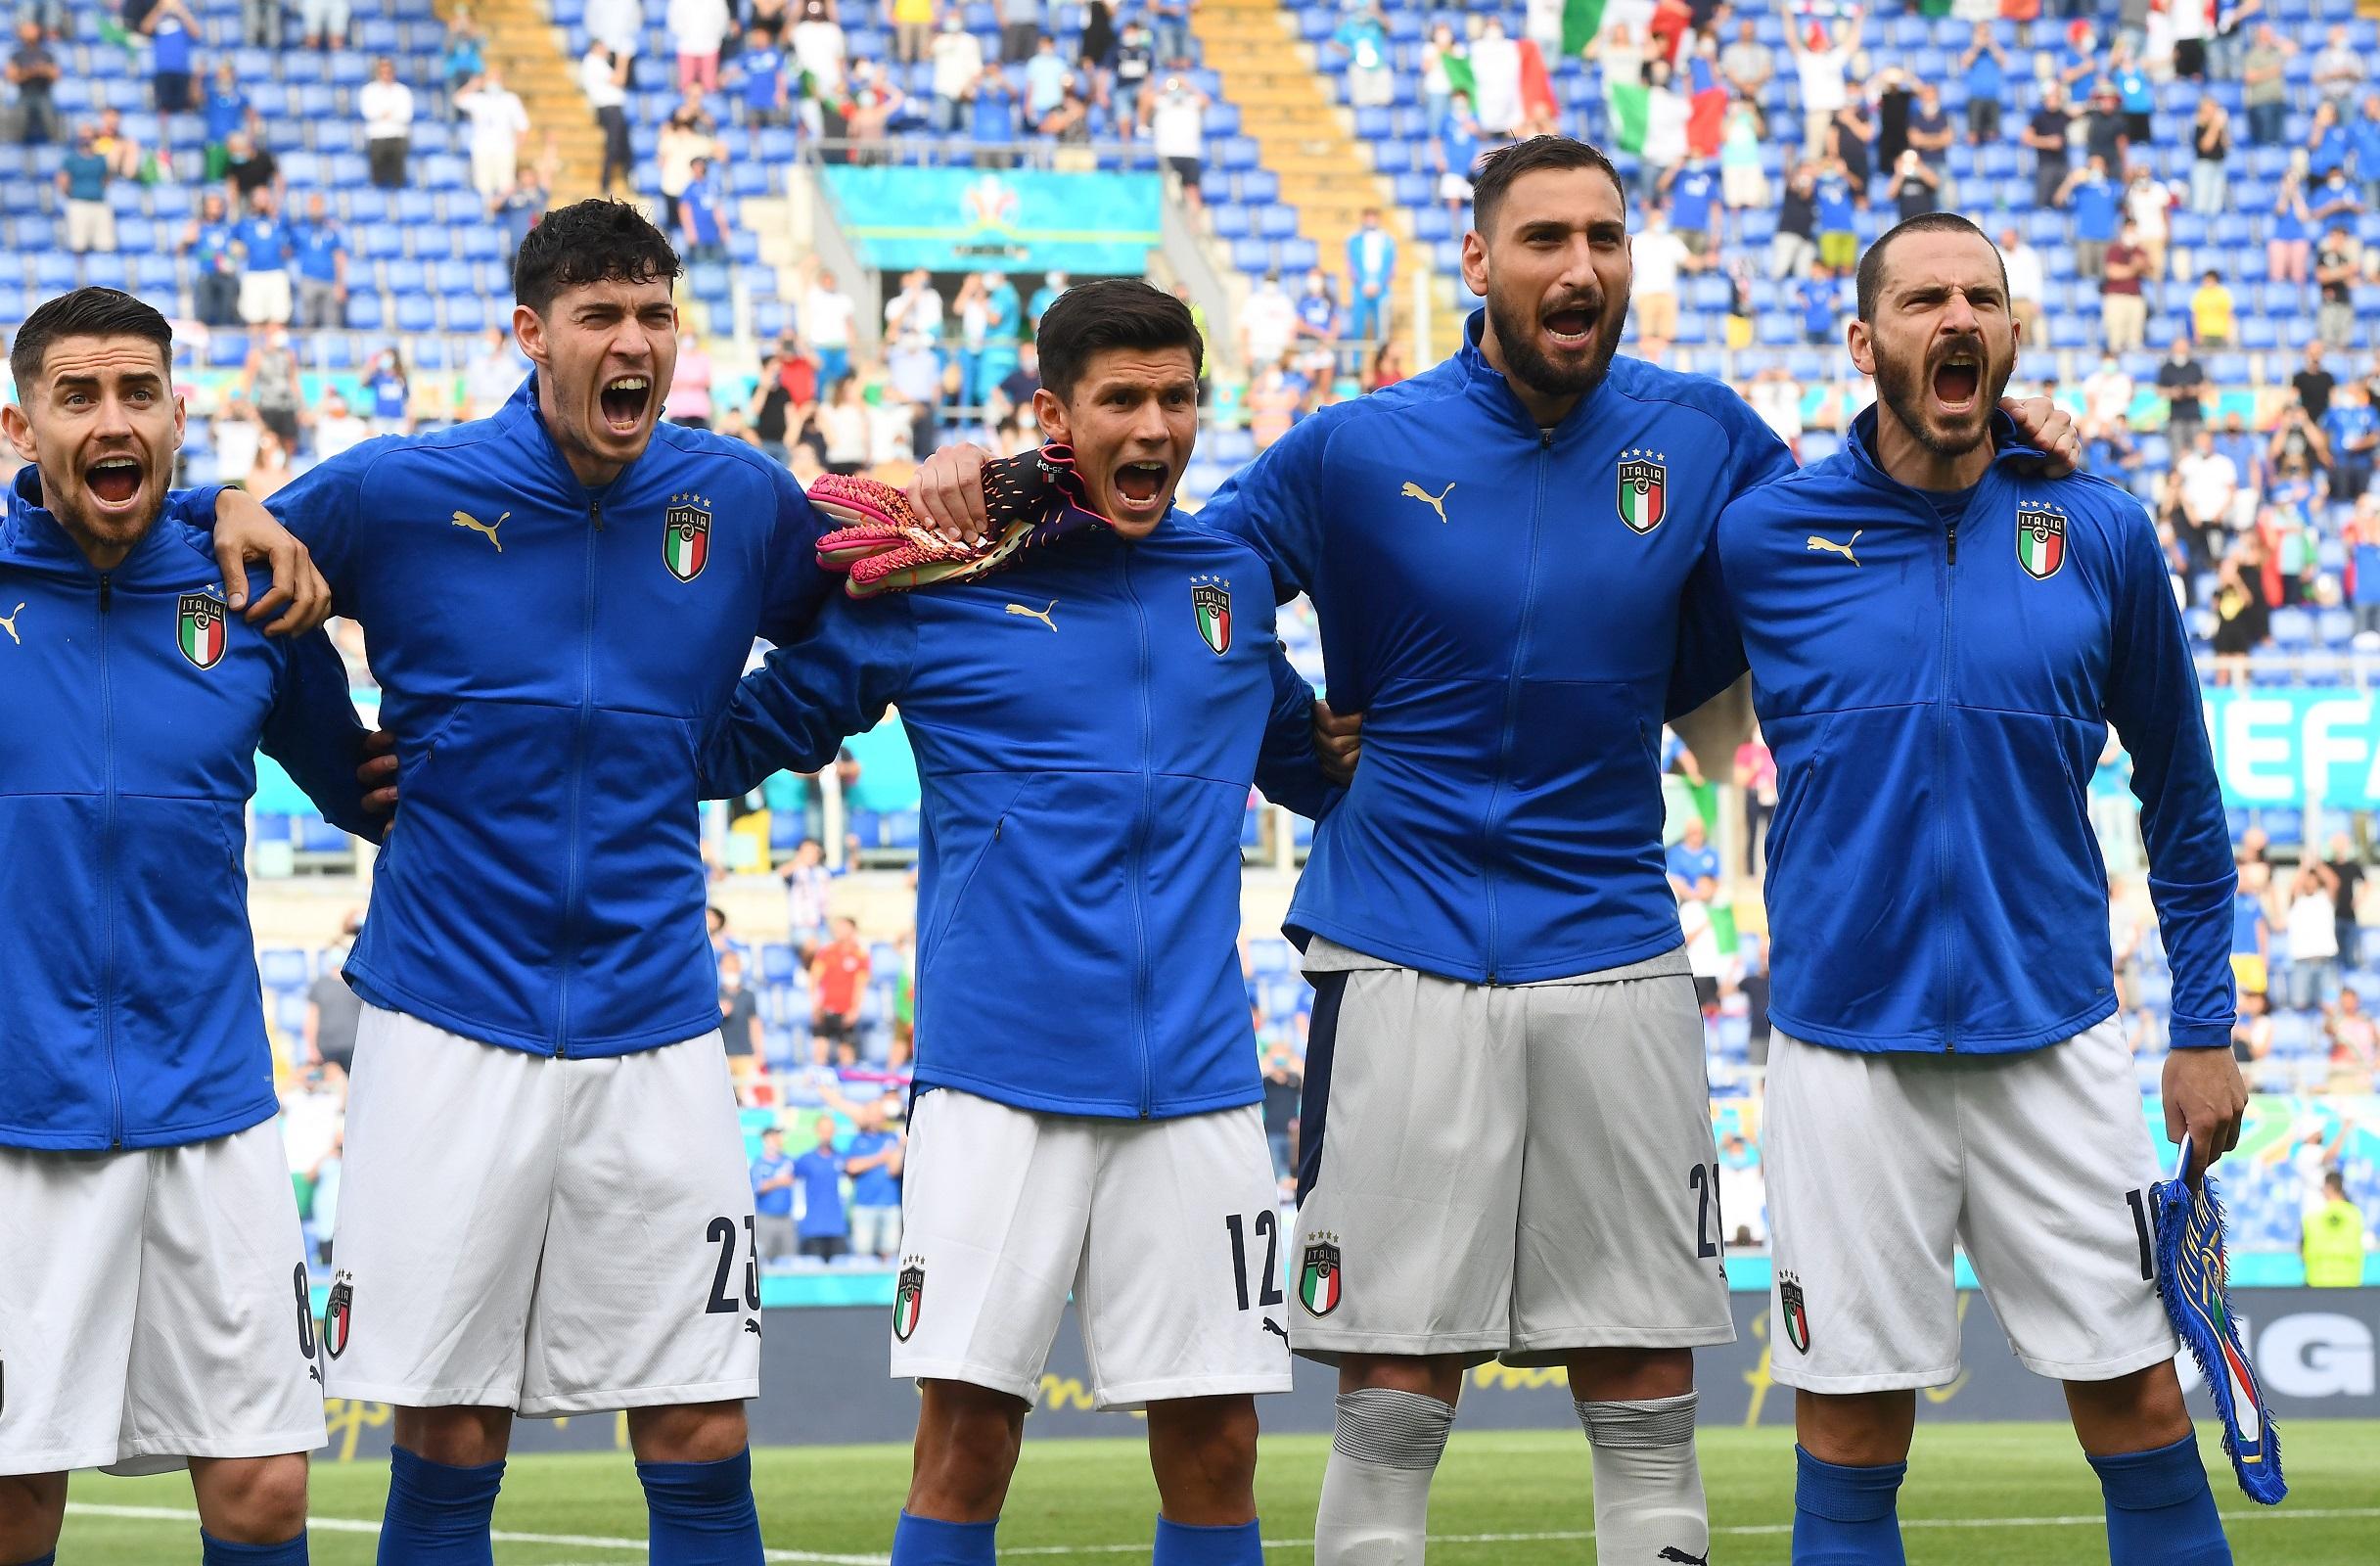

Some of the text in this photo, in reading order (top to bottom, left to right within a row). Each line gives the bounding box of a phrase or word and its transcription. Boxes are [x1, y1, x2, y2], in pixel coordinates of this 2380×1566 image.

[1623, 466, 1662, 480] ITALIA
[670, 512, 707, 527] ITALIA
[2021, 515, 2062, 530] ITALIA
[1195, 591, 1227, 607] ITALIA
[182, 599, 221, 616] ITALIA
[2201, 700, 2380, 800] EF
[1690, 1164, 1724, 1258] 21
[1225, 1209, 1283, 1311] 12
[1308, 1249, 1338, 1262] ITALIA
[706, 1215, 760, 1313] 23
[900, 1273, 921, 1285] ITALIA
[294, 1262, 315, 1359] 8
